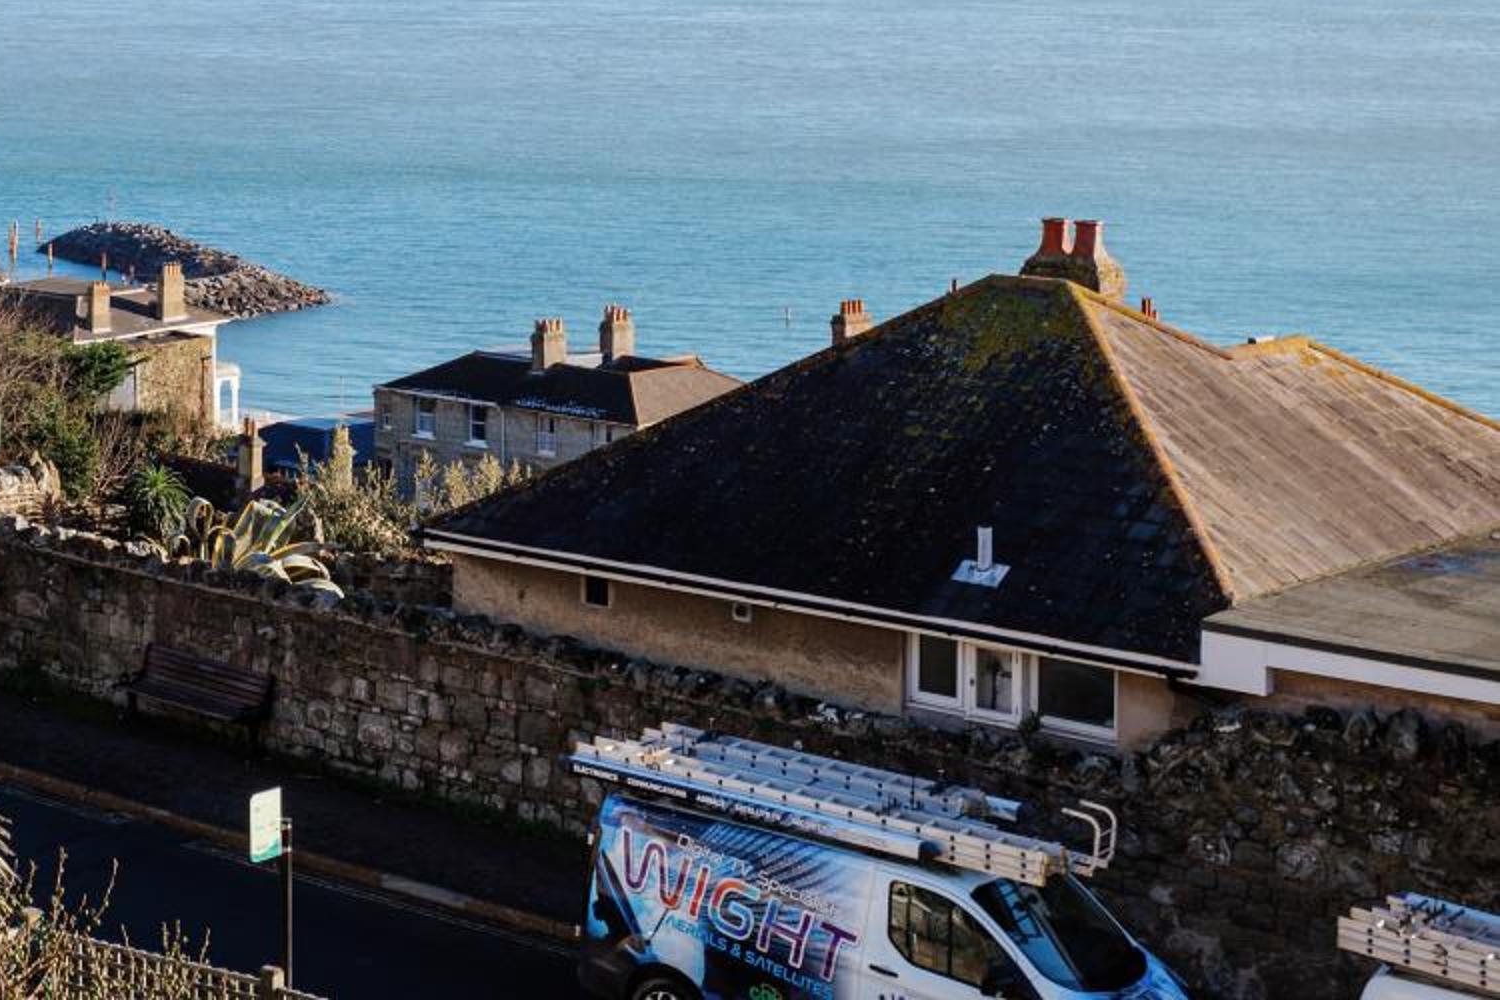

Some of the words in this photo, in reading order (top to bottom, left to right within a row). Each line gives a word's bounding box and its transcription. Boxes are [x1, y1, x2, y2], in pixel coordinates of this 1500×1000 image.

[677, 834, 725, 863] Digital
[733, 858, 753, 876] TV
[621, 826, 861, 982] WIGHT
[730, 944, 741, 959] &
[745, 951, 834, 1000] SATELLITES
